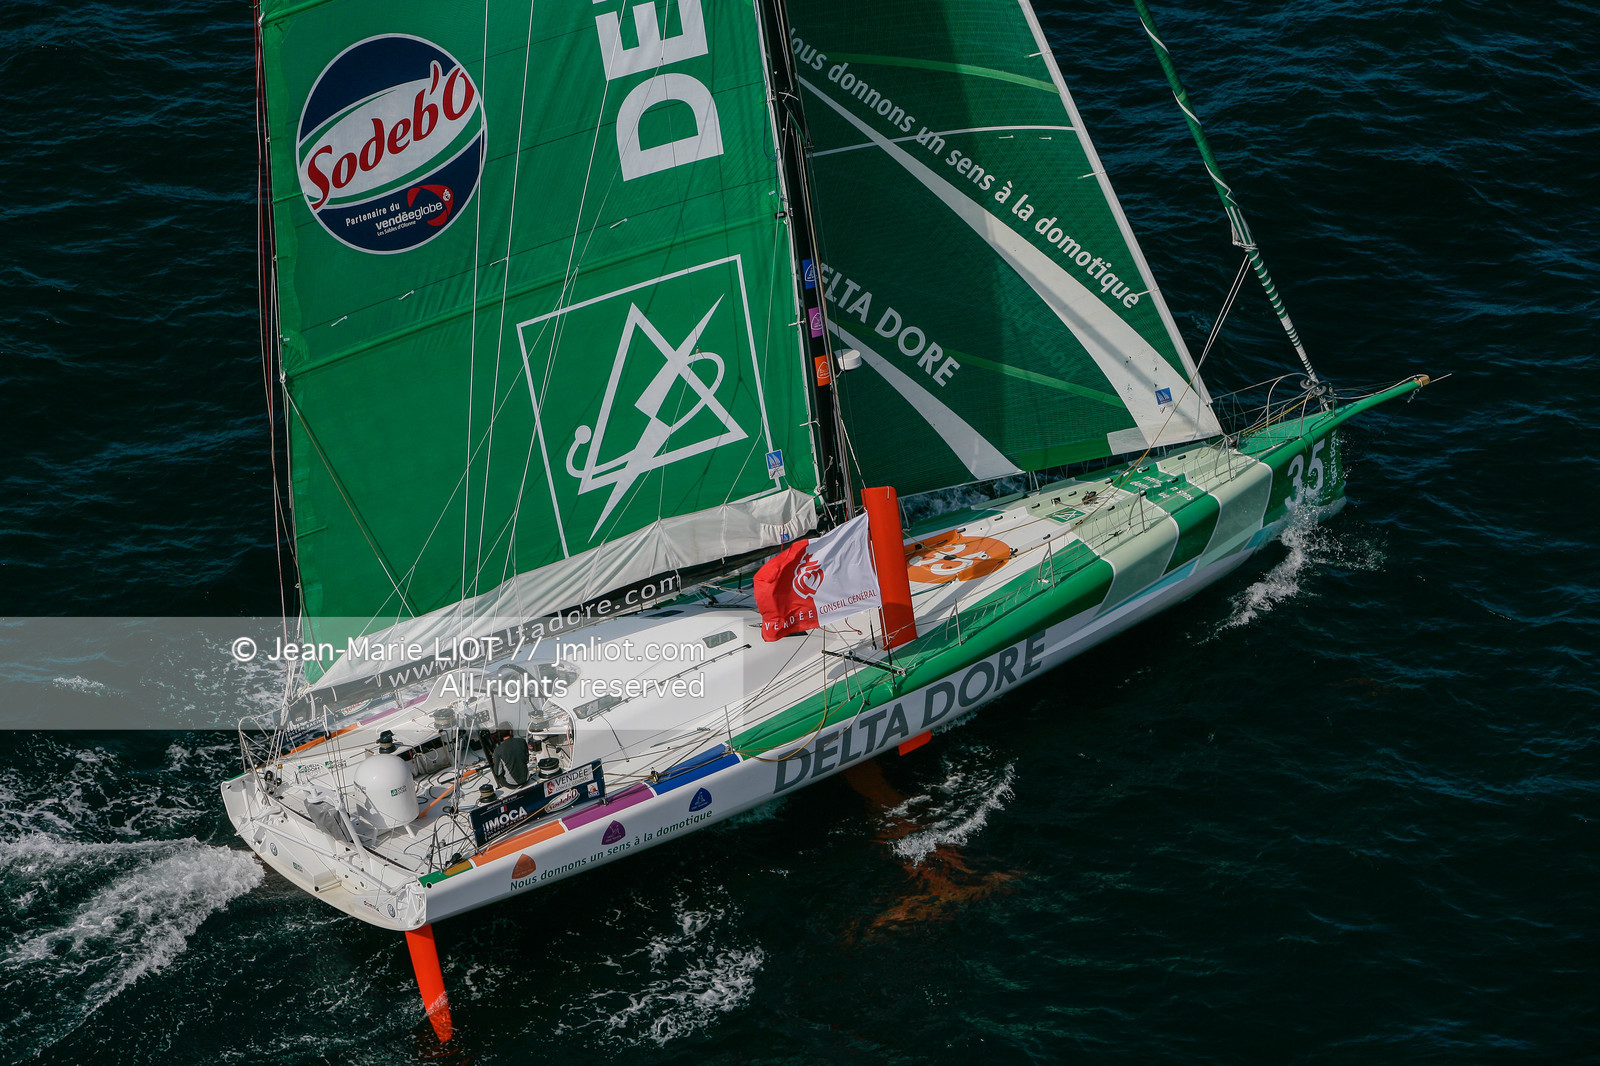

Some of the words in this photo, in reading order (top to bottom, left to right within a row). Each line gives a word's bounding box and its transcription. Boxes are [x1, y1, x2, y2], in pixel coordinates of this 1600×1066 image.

[592, 0, 724, 181] DE
[307, 64, 475, 210] Sodeb'O
[789, 27, 827, 70] ous
[828, 62, 916, 132] donnons
[916, 127, 946, 154] un
[945, 149, 996, 191] sens
[994, 181, 1013, 203] à
[1011, 194, 1035, 222] la
[1034, 217, 1139, 308] domotique
[345, 208, 387, 226] Partenaire
[390, 203, 400, 212] du
[820, 262, 873, 324] ELTA
[874, 307, 961, 387] DORE
[1285, 438, 1325, 511] 35
[764, 609, 814, 631] VENDÉE
[819, 599, 847, 615] CONSEIL
[847, 589, 877, 605] GÉNÉRAL
[774, 703, 909, 794] DELTA
[920, 629, 1046, 729] DORE
[484, 806, 528, 833] IMOCA
[510, 875, 537, 892] Nous
[540, 858, 587, 881] donnons
[590, 851, 604, 863] un
[607, 842, 631, 856] sens
[634, 836, 640, 846] à
[643, 832, 653, 843] la
[656, 810, 713, 837] domotique
